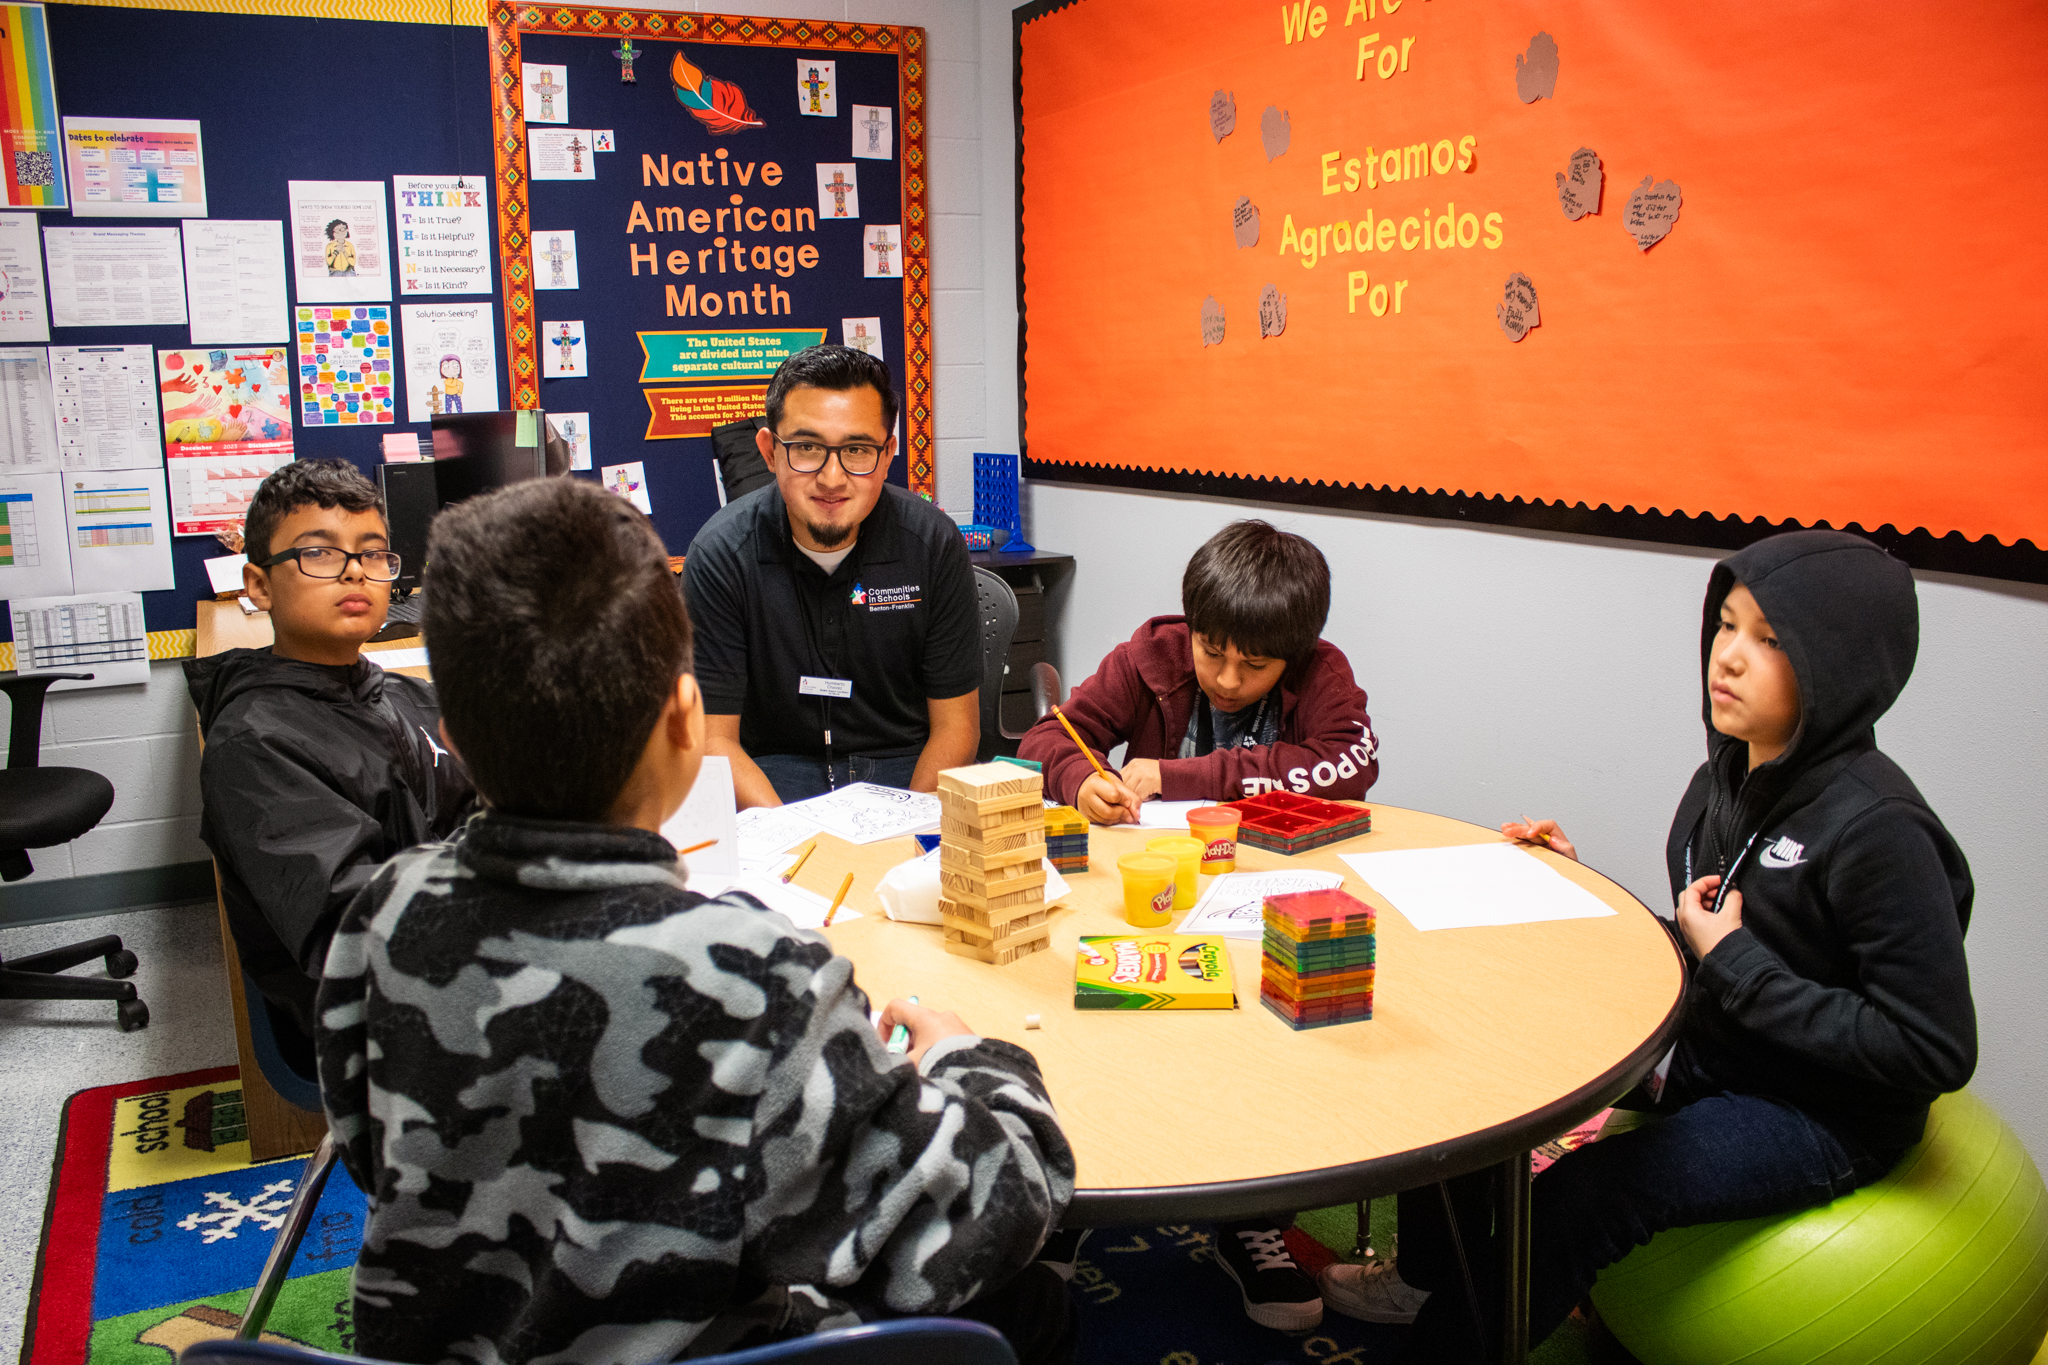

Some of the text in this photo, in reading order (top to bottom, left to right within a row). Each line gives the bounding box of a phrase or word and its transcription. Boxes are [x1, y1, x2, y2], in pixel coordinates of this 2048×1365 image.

[1282, 0, 1328, 45] We
[1356, 32, 1416, 80] For
[68, 133, 144, 143] Dates to celebrate
[642, 148, 783, 187] Native
[1321, 135, 1476, 195] Estamos
[401, 191, 481, 207] THINK
[428, 216, 434, 224] it
[436, 216, 462, 224] True?
[626, 194, 816, 234] American
[438, 233, 475, 242] Helpful?
[1279, 202, 1503, 269] Agradecidos
[417, 249, 425, 257] Is
[426, 249, 433, 257] it
[435, 249, 478, 258] Inspiring?
[630, 236, 820, 278] Heritage
[440, 266, 485, 274] Necessary?
[434, 281, 441, 289] it
[442, 281, 468, 289] Kind?
[665, 283, 791, 317] Month
[1348, 270, 1408, 317] Por
[416, 310, 478, 318] Solution-Seeking?
[686, 336, 781, 348] The United States
[679, 348, 789, 360] are divided into nine
[672, 362, 719, 374] separate
[721, 360, 763, 370] cultural
[716, 403, 741, 411] United
[670, 413, 687, 421] This
[688, 412, 721, 420] accounts
[868, 585, 920, 596] Communities
[877, 593, 910, 602] Schools
[869, 603, 915, 612] Benton-Franklin
[1109, 941, 1143, 983] MARKERS
[1199, 945, 1223, 978] Crayola
[120, 1091, 170, 1154] school
[109, 1194, 165, 1245] cold
